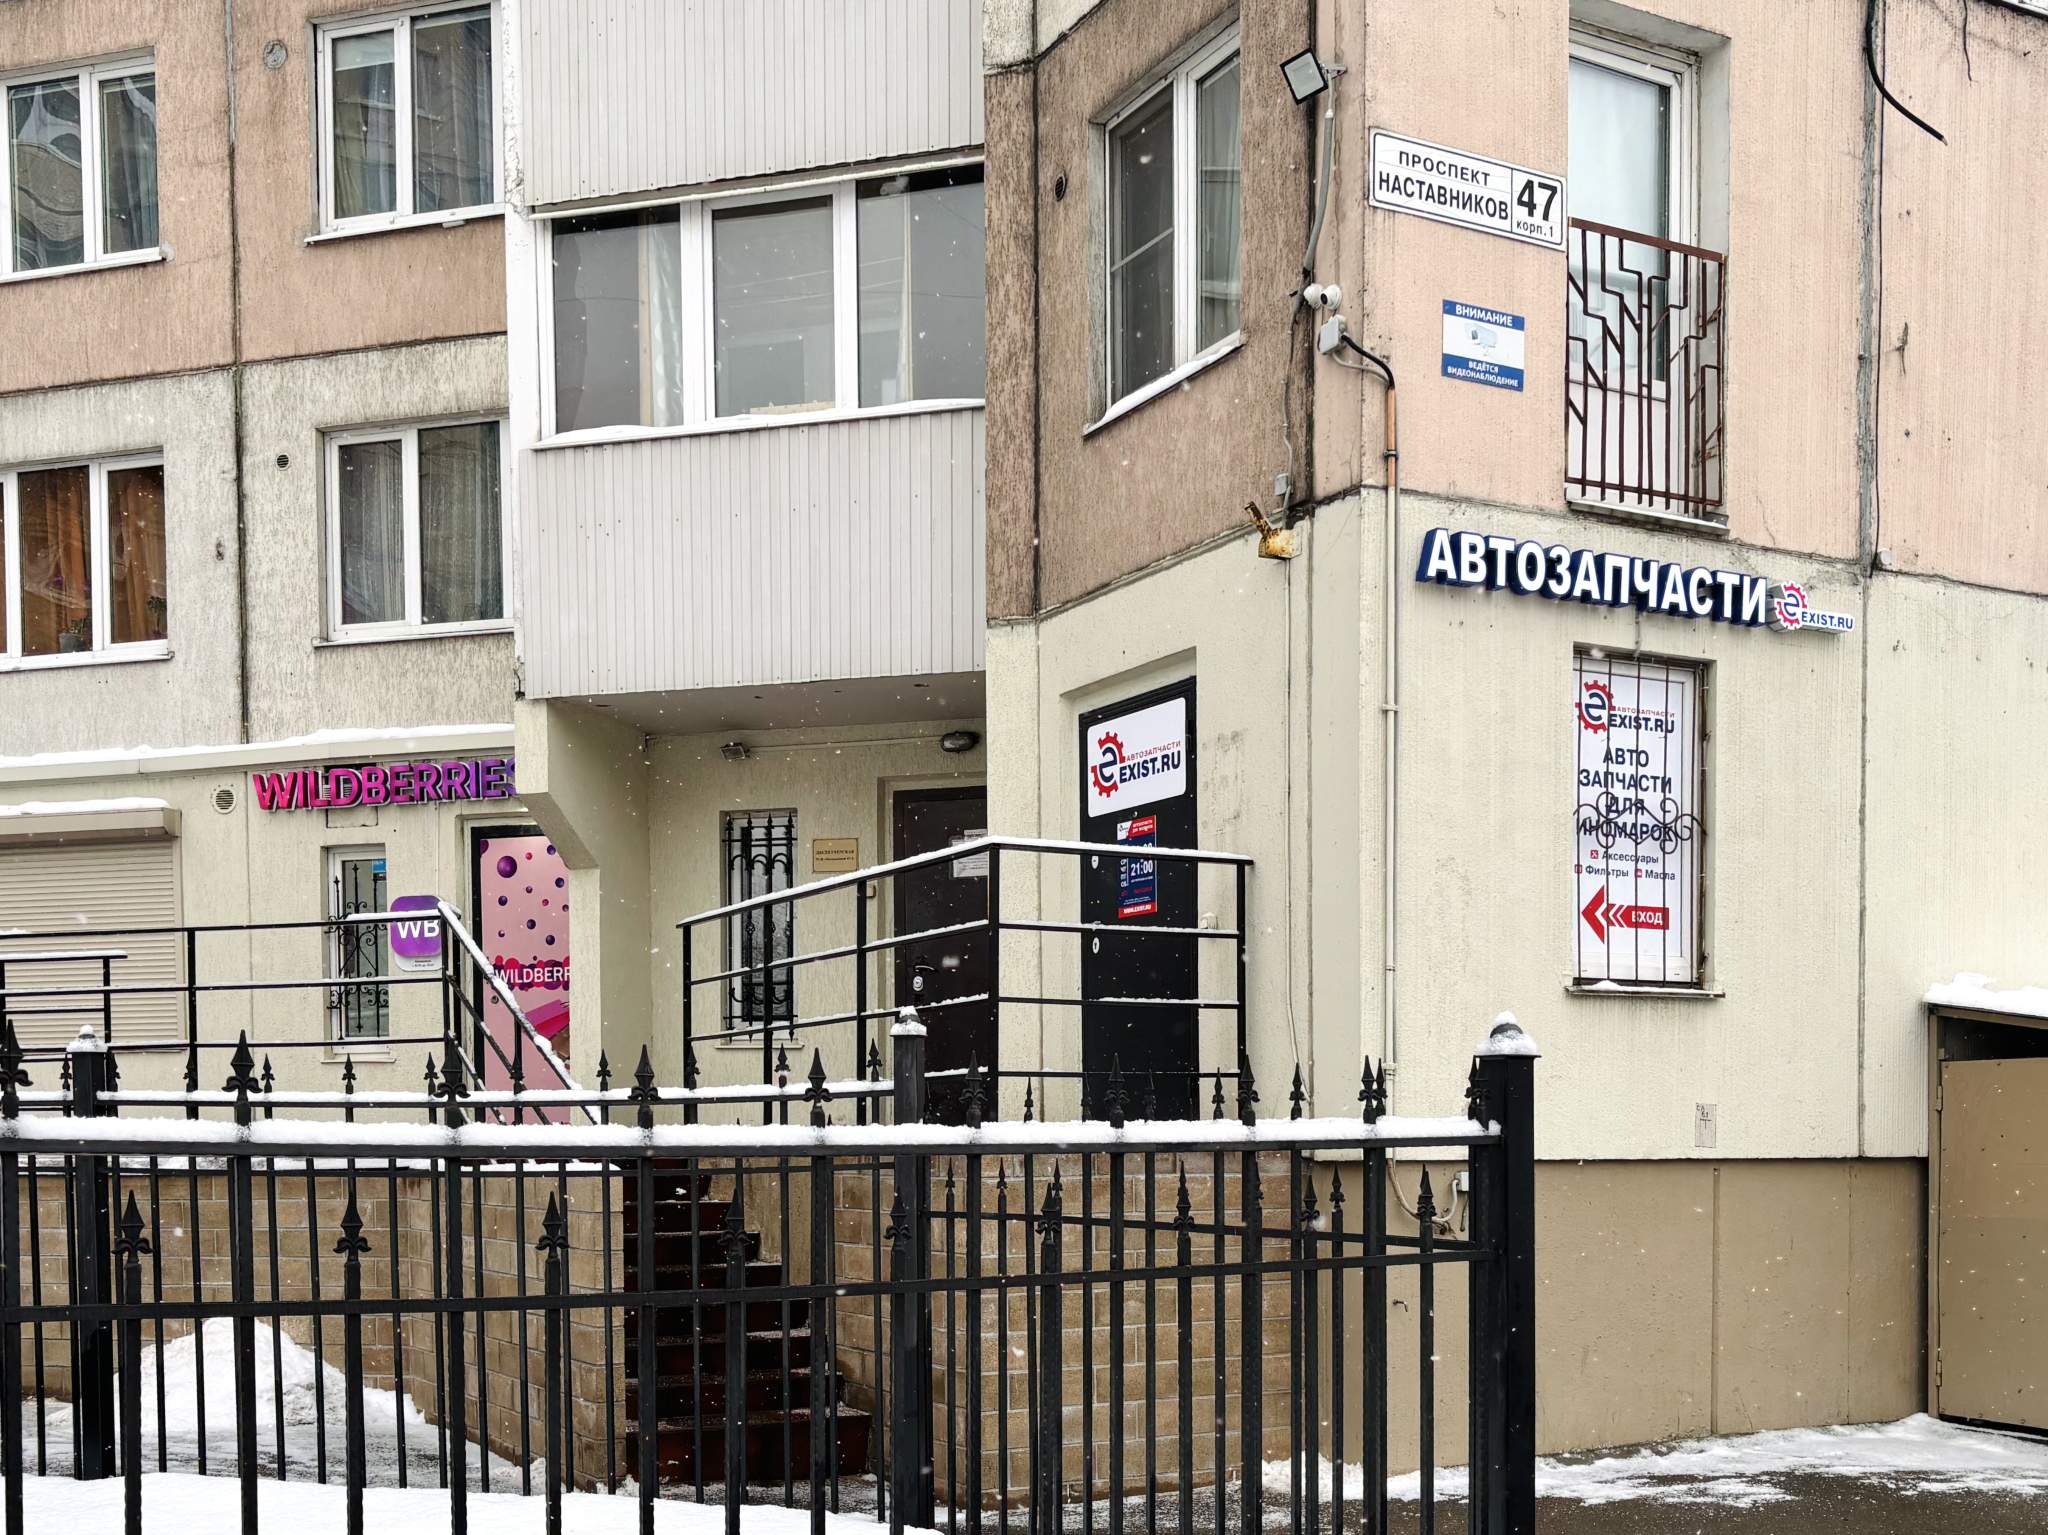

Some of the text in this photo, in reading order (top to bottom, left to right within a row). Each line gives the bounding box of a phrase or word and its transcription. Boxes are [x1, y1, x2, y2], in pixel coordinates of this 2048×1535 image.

[1399, 151, 1490, 186] ПРОСПЕКТ
[1379, 171, 1509, 220] НАСТАВНИКОВ
[1517, 179, 1558, 222] 47
[1456, 304, 1513, 327] ВНИМАНИЕ
[1447, 366, 1519, 387] ВИДЕОНАБЛЮДЕНИЕ
[1417, 528, 1767, 626] АВТОЗАПЧАСТИ
[1801, 611, 1854, 630] EXIST.RU
[1609, 714, 1675, 734] EXIST.RU
[1127, 740, 1181, 762] АВТОЗАПЧАСТИ
[1603, 746, 1650, 768] АВТО
[1119, 750, 1181, 784] EXIST.RU
[1580, 769, 1672, 794] ЗАПЧАСТИ
[1131, 860, 1154, 876] 21:00
[1645, 870, 1676, 880] Масла
[1631, 910, 1663, 925] ВХОД
[397, 920, 440, 939] WB
